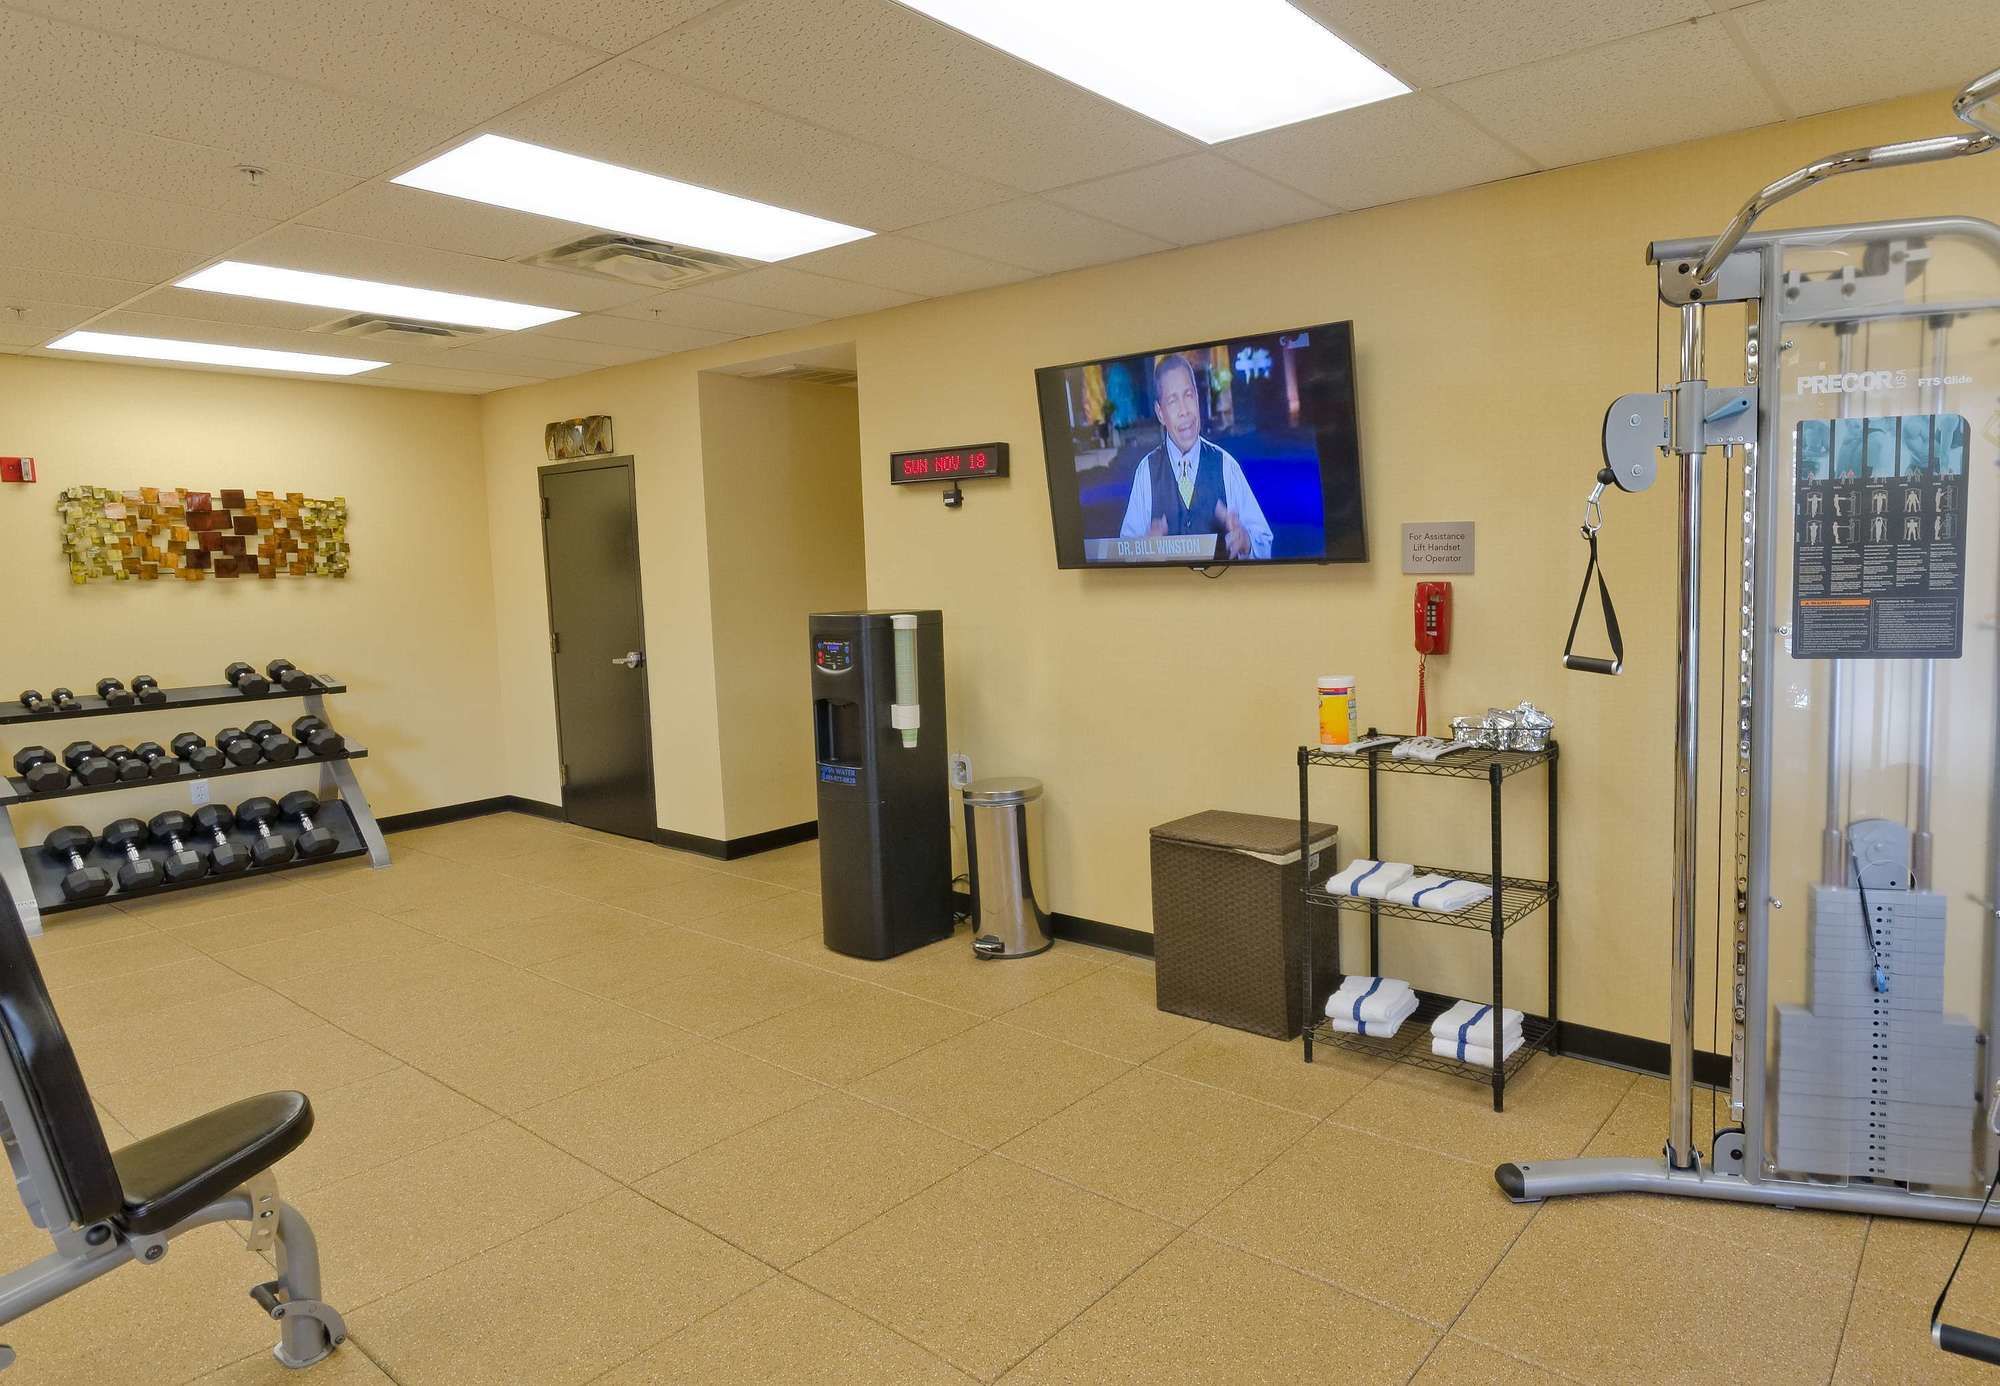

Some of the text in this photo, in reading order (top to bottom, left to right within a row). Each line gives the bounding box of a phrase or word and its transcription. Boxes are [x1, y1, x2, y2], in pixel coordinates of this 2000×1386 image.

[1797, 371, 1893, 394] PRECOR
[1918, 375, 1974, 387] FTS Glide
[904, 453, 985, 475] SUN NOV 18
[1408, 532, 1465, 541] For Assistance
[1118, 541, 1133, 556] DR.
[1157, 538, 1200, 554] WINSTON
[1413, 543, 1461, 551] Lift Handset
[1412, 554, 1462, 564] for Operator
